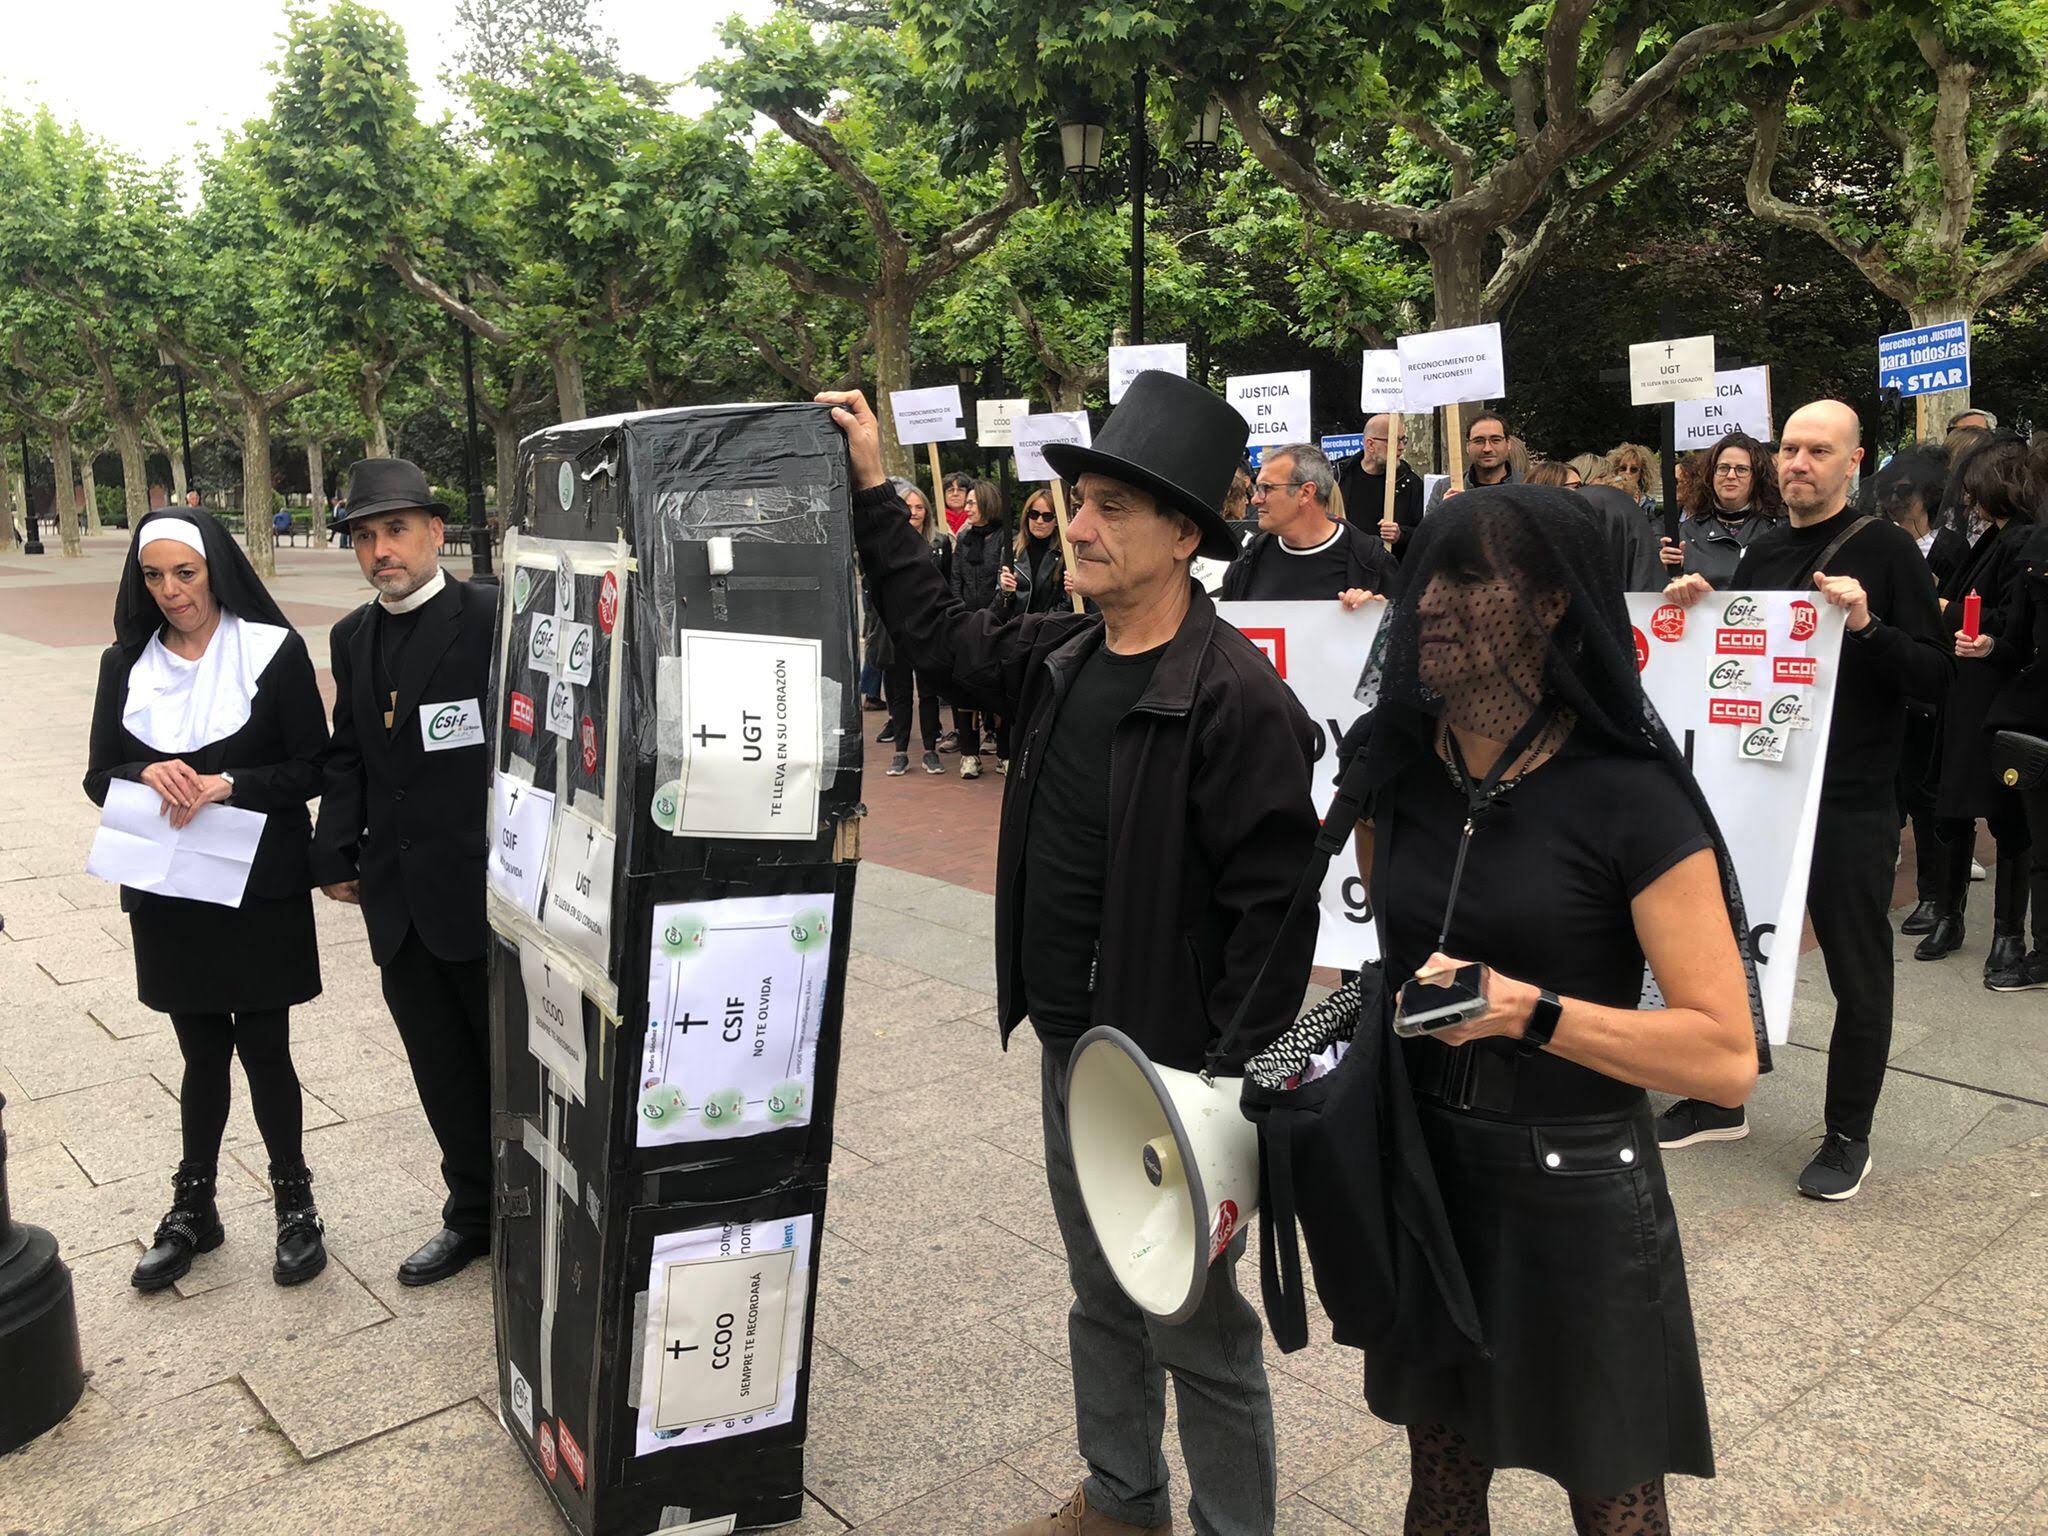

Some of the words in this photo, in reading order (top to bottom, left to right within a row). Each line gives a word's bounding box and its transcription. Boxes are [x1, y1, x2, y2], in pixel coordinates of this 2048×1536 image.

[1880, 337, 1916, 352] derechos
[1917, 334, 1929, 344] en
[1930, 326, 1963, 342] JUSTICIA
[1408, 355, 1475, 371] RECONOCIMIENTO
[1881, 352, 1908, 370] para
[1910, 341, 1967, 364] todos/as
[1423, 368, 1473, 381] FUNCIONES!!!
[1660, 364, 1680, 375] UGT
[1907, 368, 1963, 391] STAR
[1239, 385, 1290, 400] JUSTICIA
[1716, 384, 1743, 397] ICIA
[1257, 405, 1272, 416] EN
[1704, 405, 1723, 417] EN
[1249, 422, 1289, 435] UELGA
[1687, 422, 1743, 438] HUELGA
[1658, 608, 1681, 620] UGT
[1718, 633, 1765, 646] CCOO
[774, 659, 787, 720] CORAZÓN
[1712, 703, 1760, 717] CCOO
[743, 710, 762, 762] UGT
[777, 723, 787, 740] SU
[777, 743, 787, 760] EN
[774, 763, 787, 799] LLEVA
[771, 802, 781, 817] TE
[502, 828, 518, 852] CSIF
[576, 871, 592, 899] UGT
[759, 976, 773, 1021] OLVIDA
[542, 996, 565, 1027] CCOO
[722, 996, 746, 1043] CSIF
[756, 1023, 767, 1035] TE
[753, 1042, 765, 1057] NO
[782, 1223, 795, 1249] lient
[746, 1272, 762, 1337] RECORDARÁ
[711, 1312, 735, 1370] CCOO
[745, 1338, 755, 1352] TE
[740, 1352, 753, 1397] SIEMPRE
